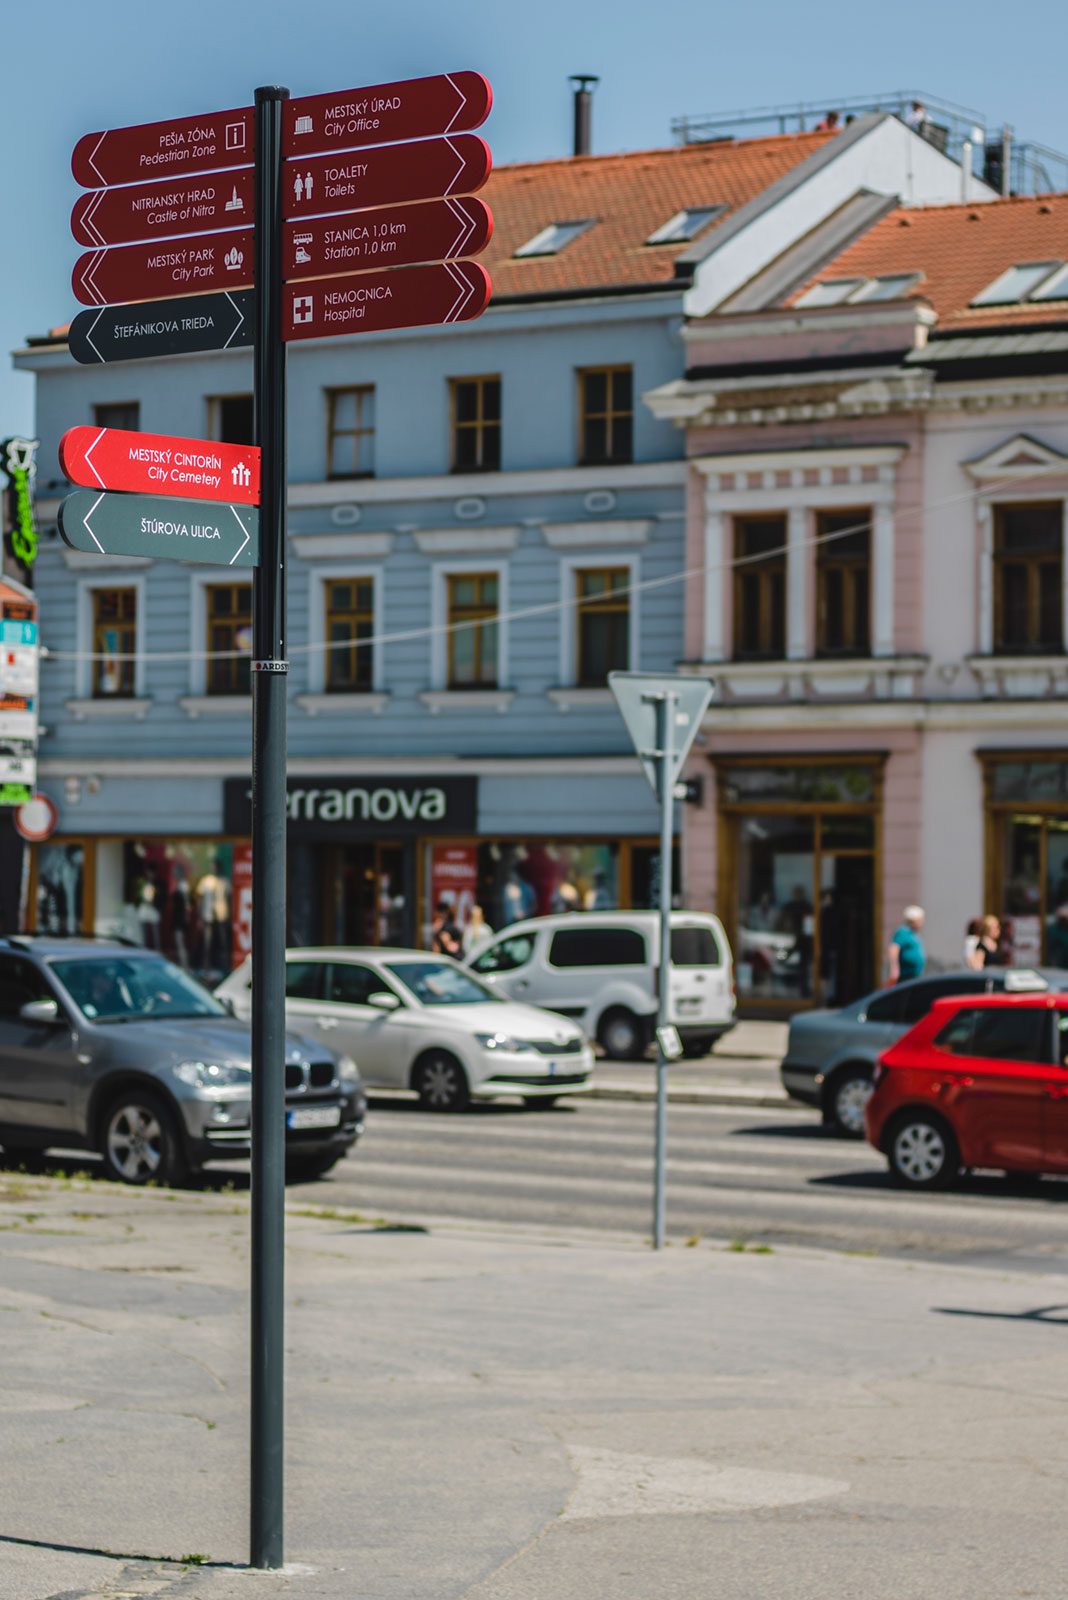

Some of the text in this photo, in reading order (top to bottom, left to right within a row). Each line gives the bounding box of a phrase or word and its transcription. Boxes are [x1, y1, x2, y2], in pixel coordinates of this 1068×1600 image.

[325, 96, 401, 120] MESTSKÝ ÚRAD
[159, 127, 216, 147] PEŠIA ZÓNA
[325, 117, 380, 137] City Office
[139, 144, 216, 167] Pedestrian Zone
[325, 164, 368, 182] TOALETY
[132, 188, 216, 212] NITRIANSKY HRAD
[325, 182, 356, 198] Toilets
[147, 204, 216, 225] Castle of Nitra
[325, 222, 406, 244] STANICA 1,0 km
[147, 248, 215, 269] MESTSKÝ PARK
[324, 239, 396, 261] Station 1,0 km
[172, 262, 214, 282] City Park
[325, 287, 393, 305] NEMOCNICA
[324, 306, 366, 323] Hospital
[114, 316, 214, 340] ŠTEFÁNIKOVA TRIEDA
[129, 448, 222, 470] MESTSKÝ CINTORÍN
[148, 467, 222, 488] City Cemetery
[140, 518, 221, 539] ŠTÚROVA ULICA
[246, 787, 447, 821] rranova
